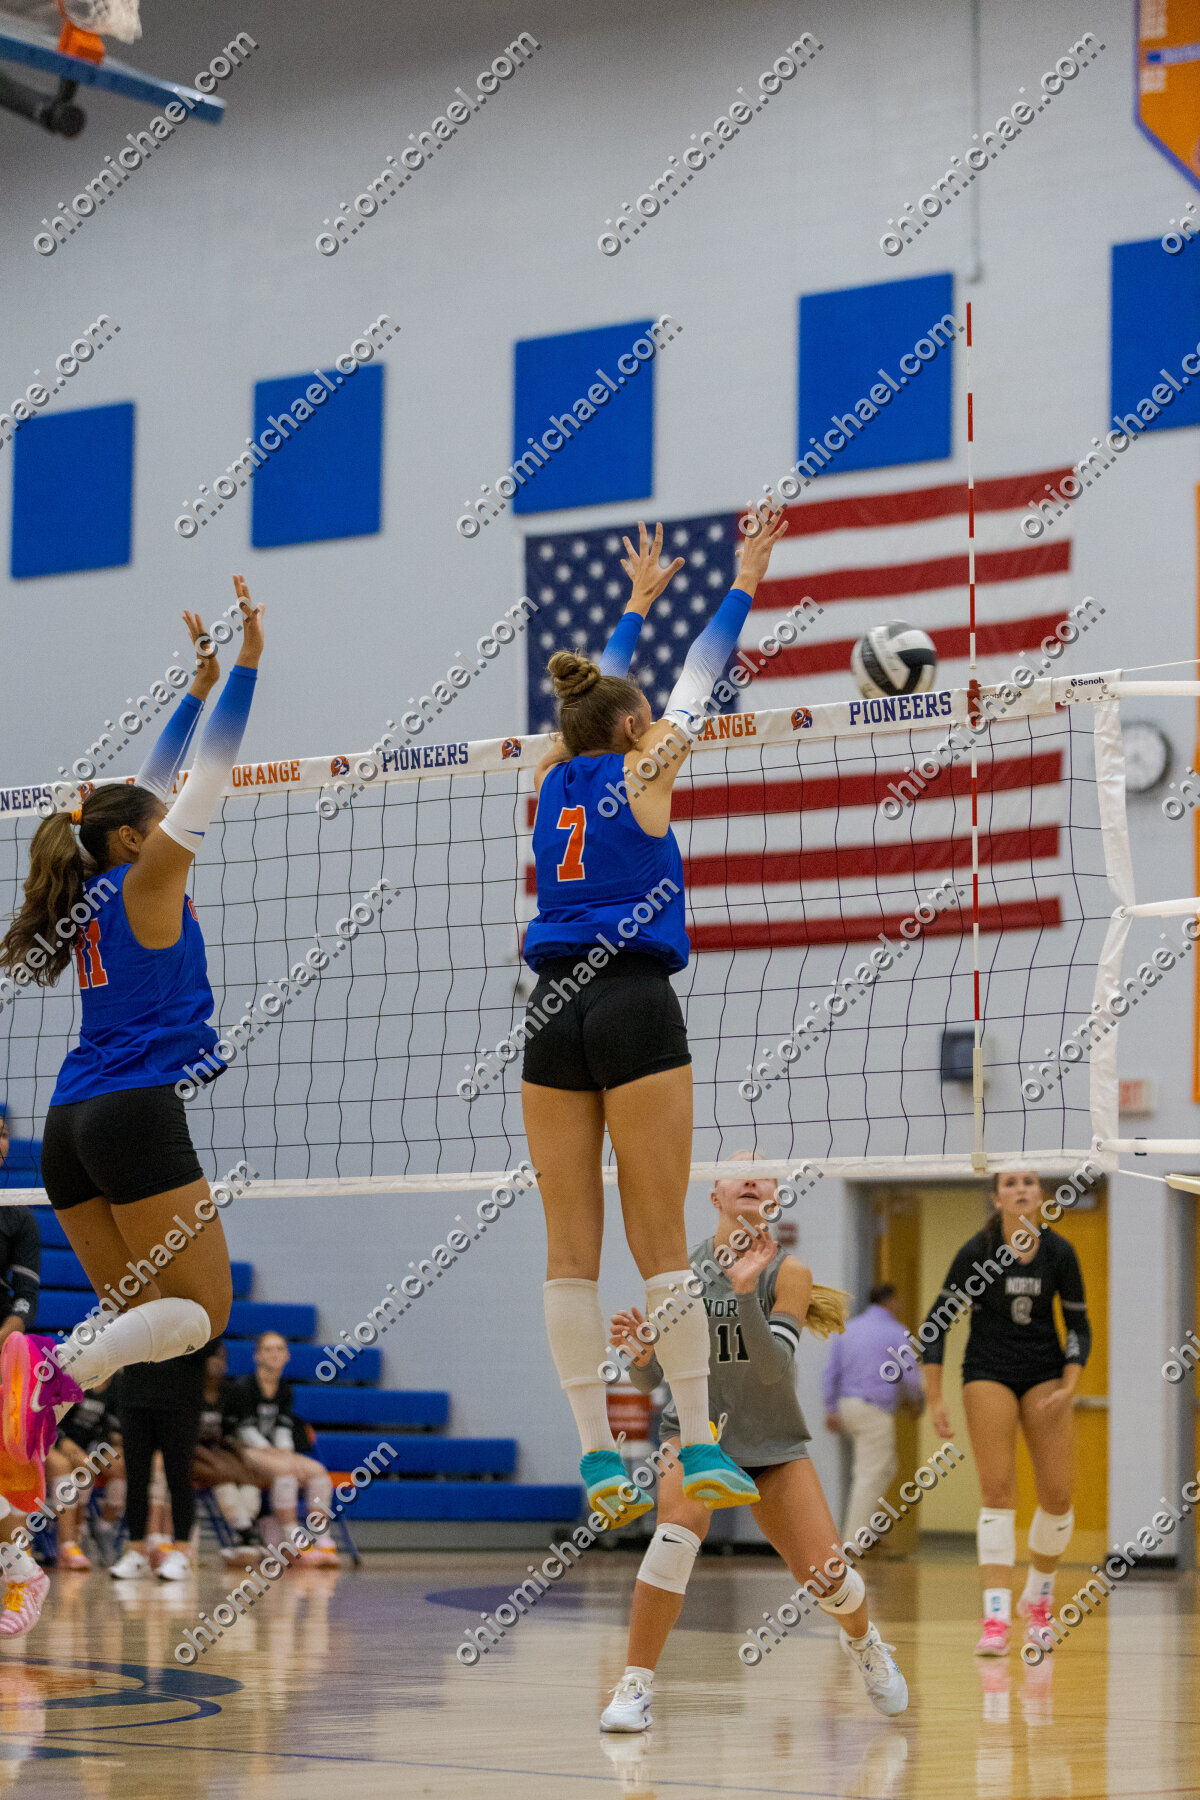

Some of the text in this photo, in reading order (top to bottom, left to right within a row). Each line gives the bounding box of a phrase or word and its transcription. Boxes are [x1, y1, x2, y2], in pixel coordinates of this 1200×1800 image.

[1077, 677, 1105, 687] Senoh
[849, 691, 952, 725] PIONEERS
[697, 712, 757, 741] ANGE
[382, 742, 469, 772] PIONEERS
[232, 760, 300, 788] ORANGE
[556, 805, 587, 882] 7
[703, 1297, 739, 1318] NOR
[716, 1323, 751, 1364] 11
